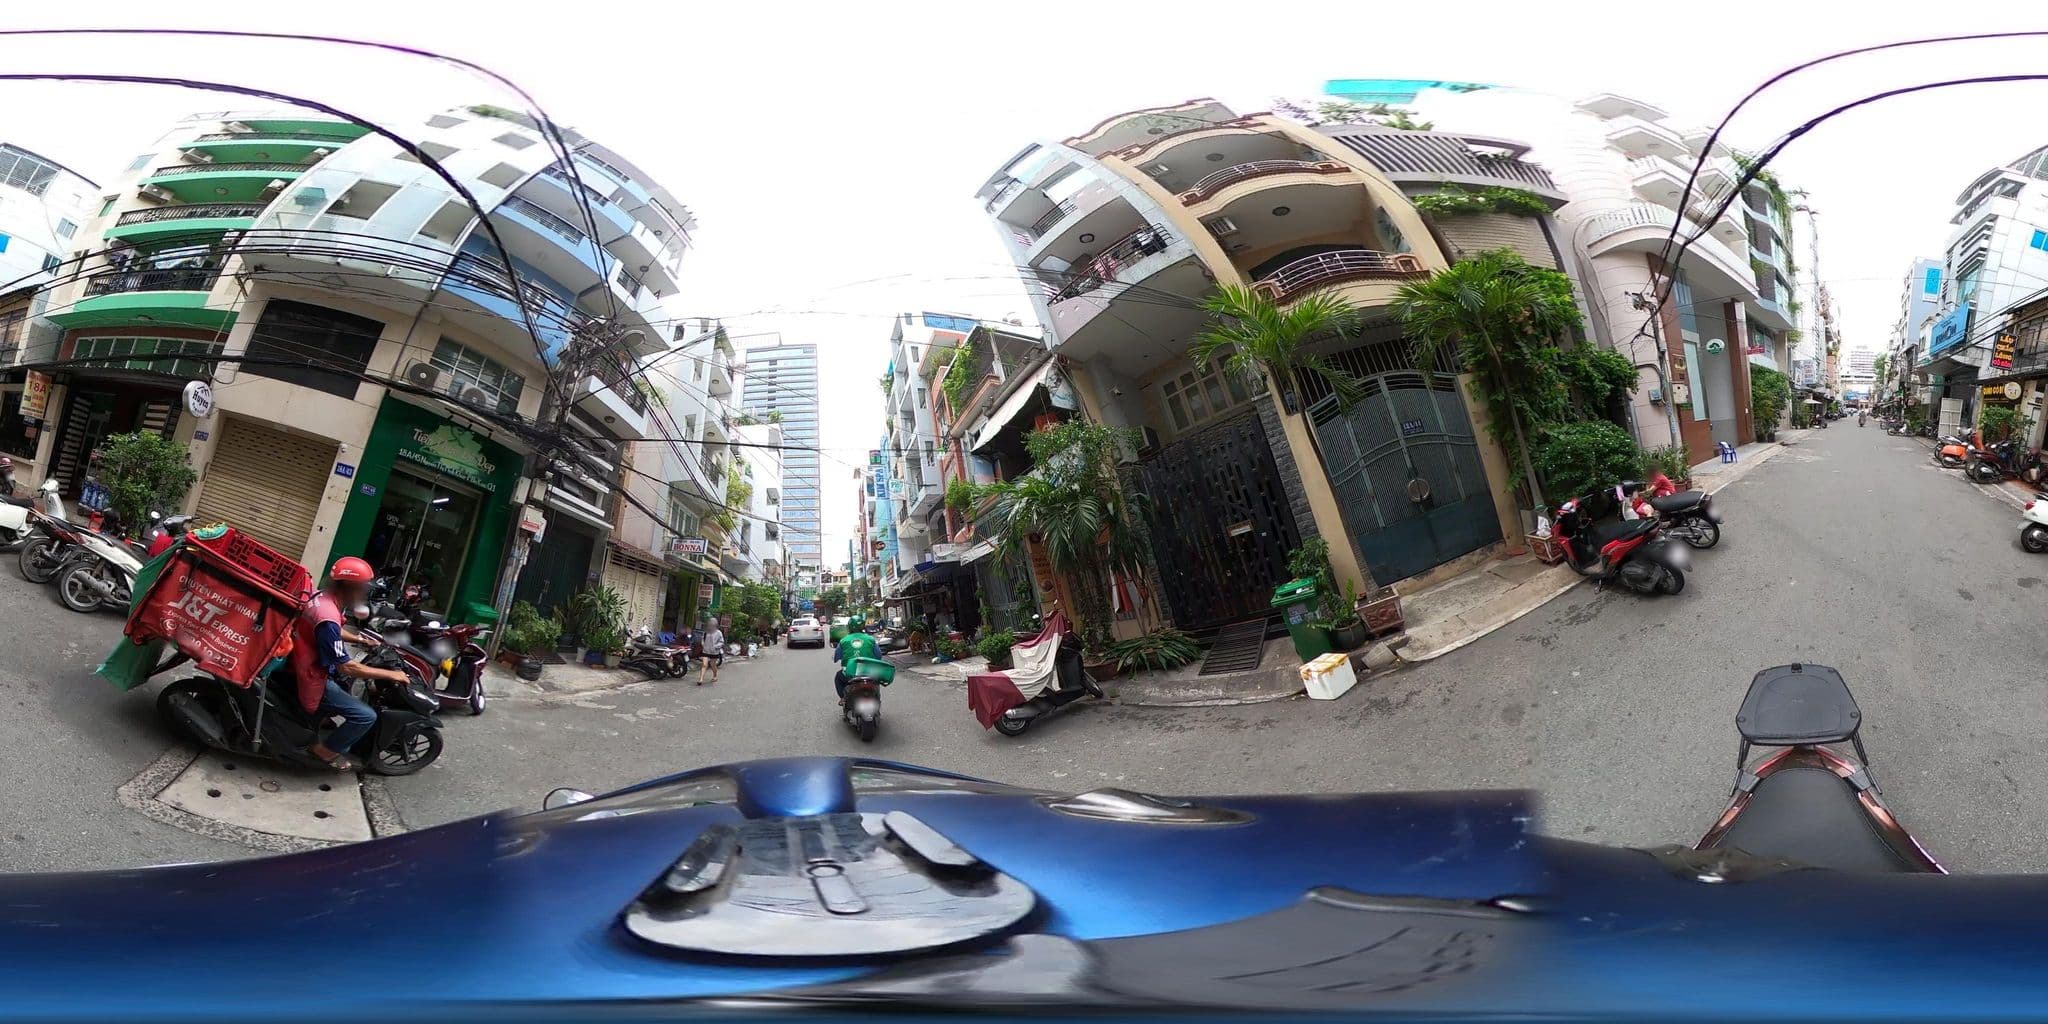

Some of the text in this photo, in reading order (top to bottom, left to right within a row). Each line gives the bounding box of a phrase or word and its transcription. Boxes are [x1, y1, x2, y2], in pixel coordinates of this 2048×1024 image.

[29, 381, 47, 393] 18A
[167, 591, 229, 625] J&T
[211, 619, 250, 645] EXPRESS
